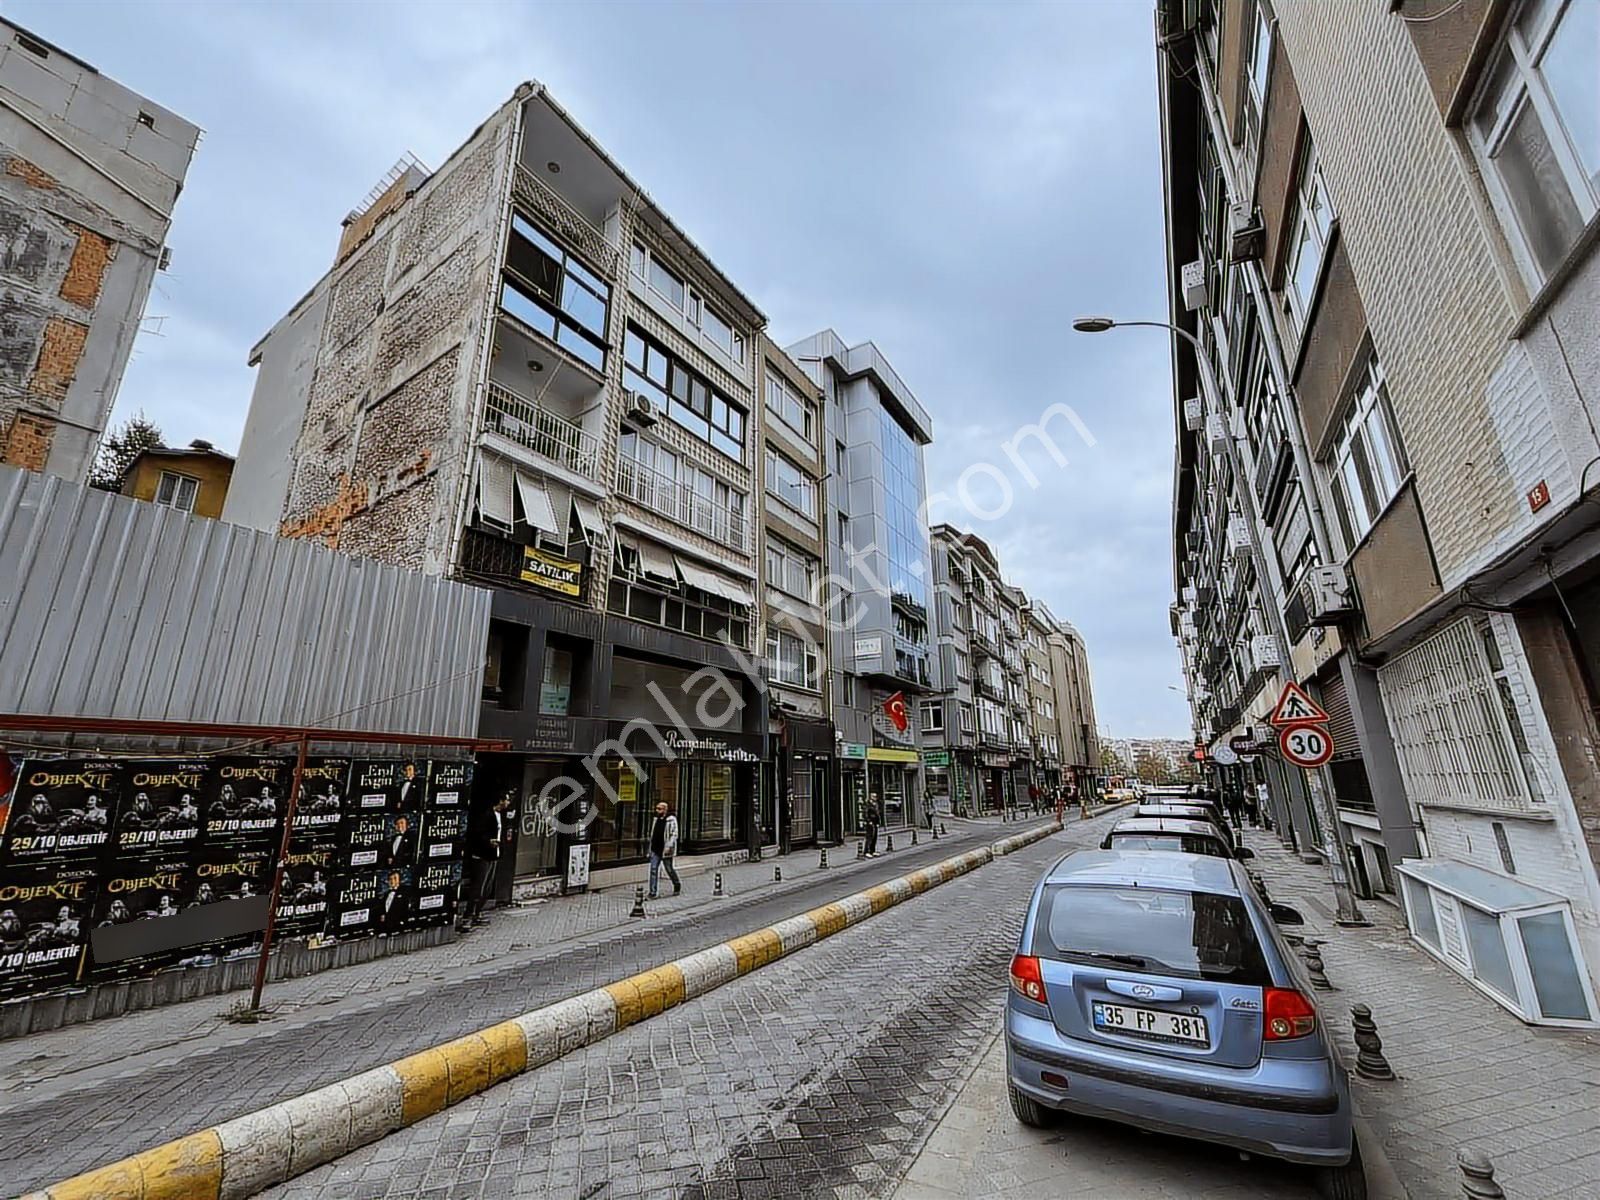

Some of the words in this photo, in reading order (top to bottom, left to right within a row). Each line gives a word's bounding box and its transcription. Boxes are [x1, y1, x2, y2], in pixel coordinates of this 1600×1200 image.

[529, 560, 574, 582] SATILIK
[1291, 734, 1321, 755] 30
[207, 819, 240, 832] 29/10
[11, 835, 56, 850] 29/10
[119, 830, 157, 844] 29/10
[1105, 1006, 1124, 1026] 35
[1136, 1011, 1156, 1031] FP
[1170, 1017, 1200, 1038] 381
